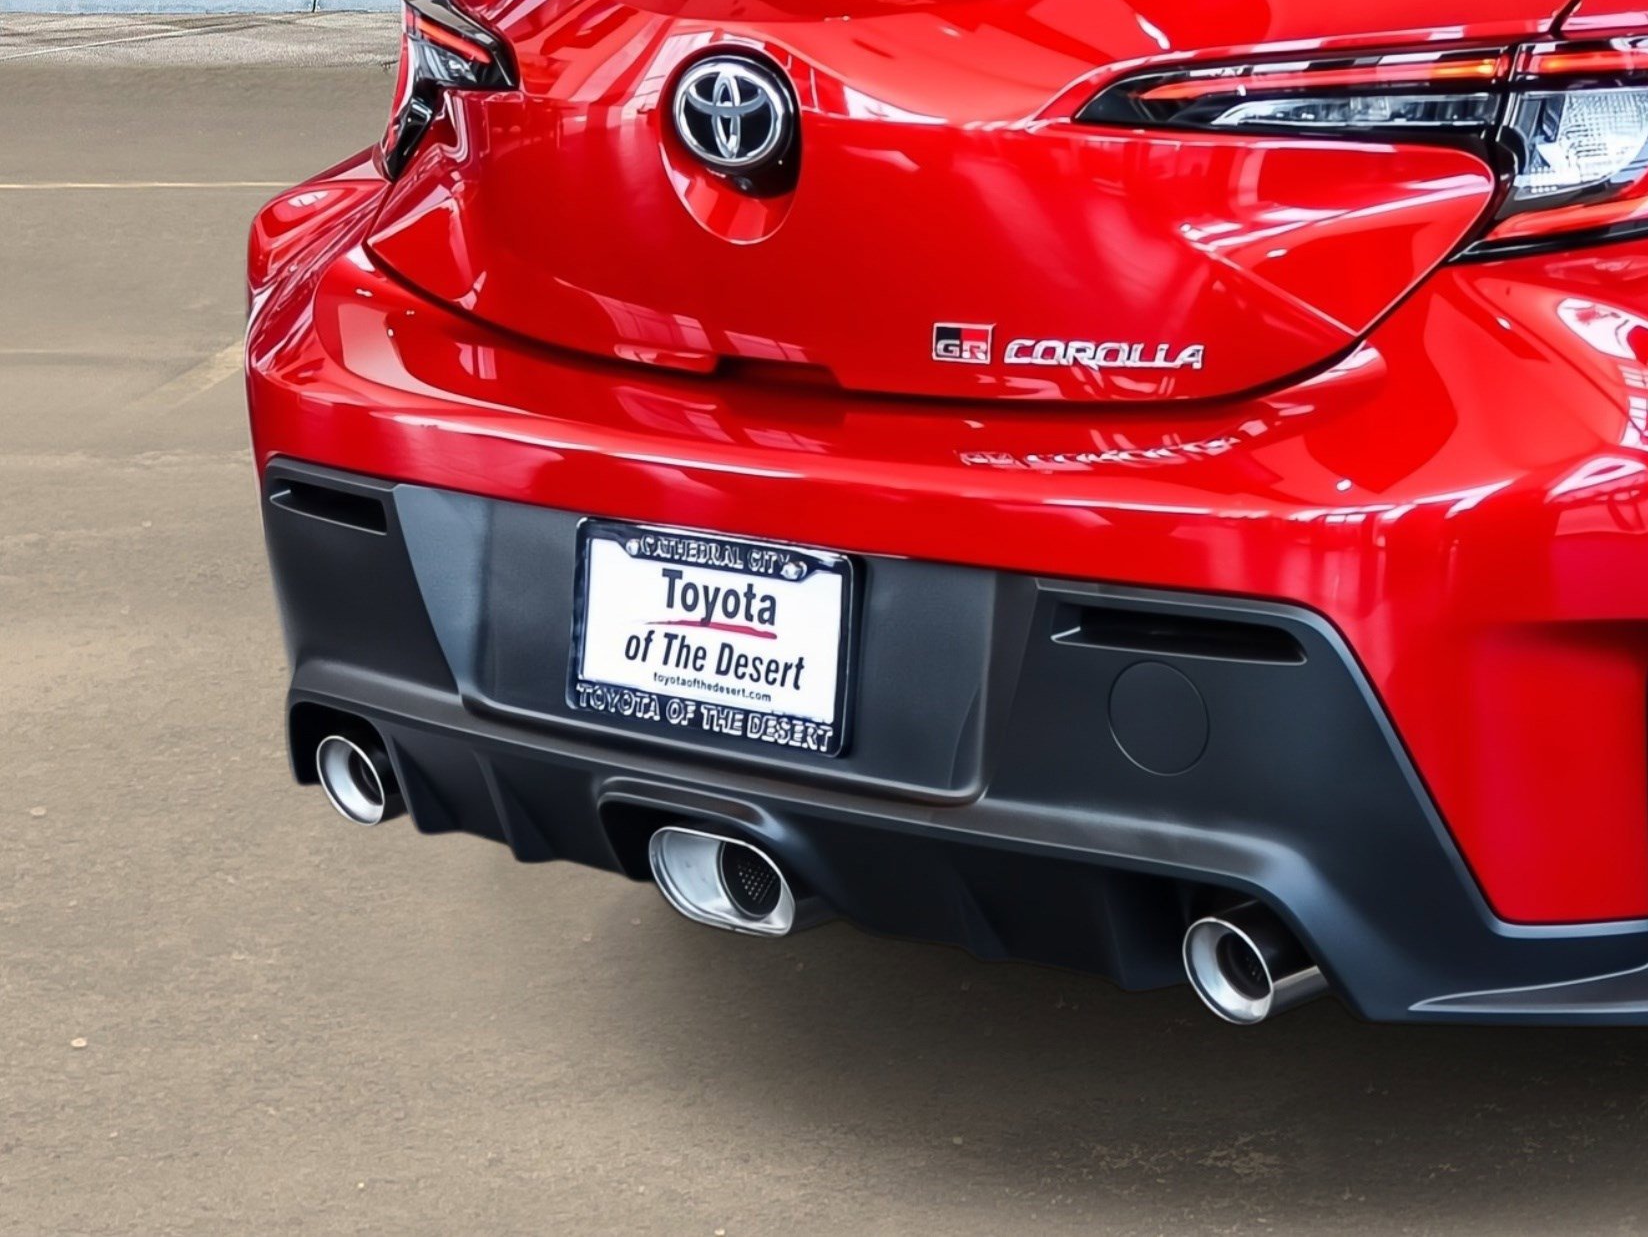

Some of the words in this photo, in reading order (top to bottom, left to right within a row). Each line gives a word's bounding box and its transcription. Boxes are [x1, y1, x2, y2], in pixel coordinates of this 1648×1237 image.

[935, 339, 988, 360] GR
[1003, 339, 1205, 370] COROLLA
[640, 535, 743, 570] CATHEDRAL
[661, 568, 778, 627] Toyota
[624, 630, 656, 662] of
[662, 632, 707, 673] The
[715, 642, 805, 691] Desert
[653, 671, 772, 703] toyotaofthedesert.com
[576, 682, 661, 722] TOYOTA
[666, 698, 696, 726] OF
[700, 705, 744, 737] THE
[747, 713, 834, 753] DESERT
